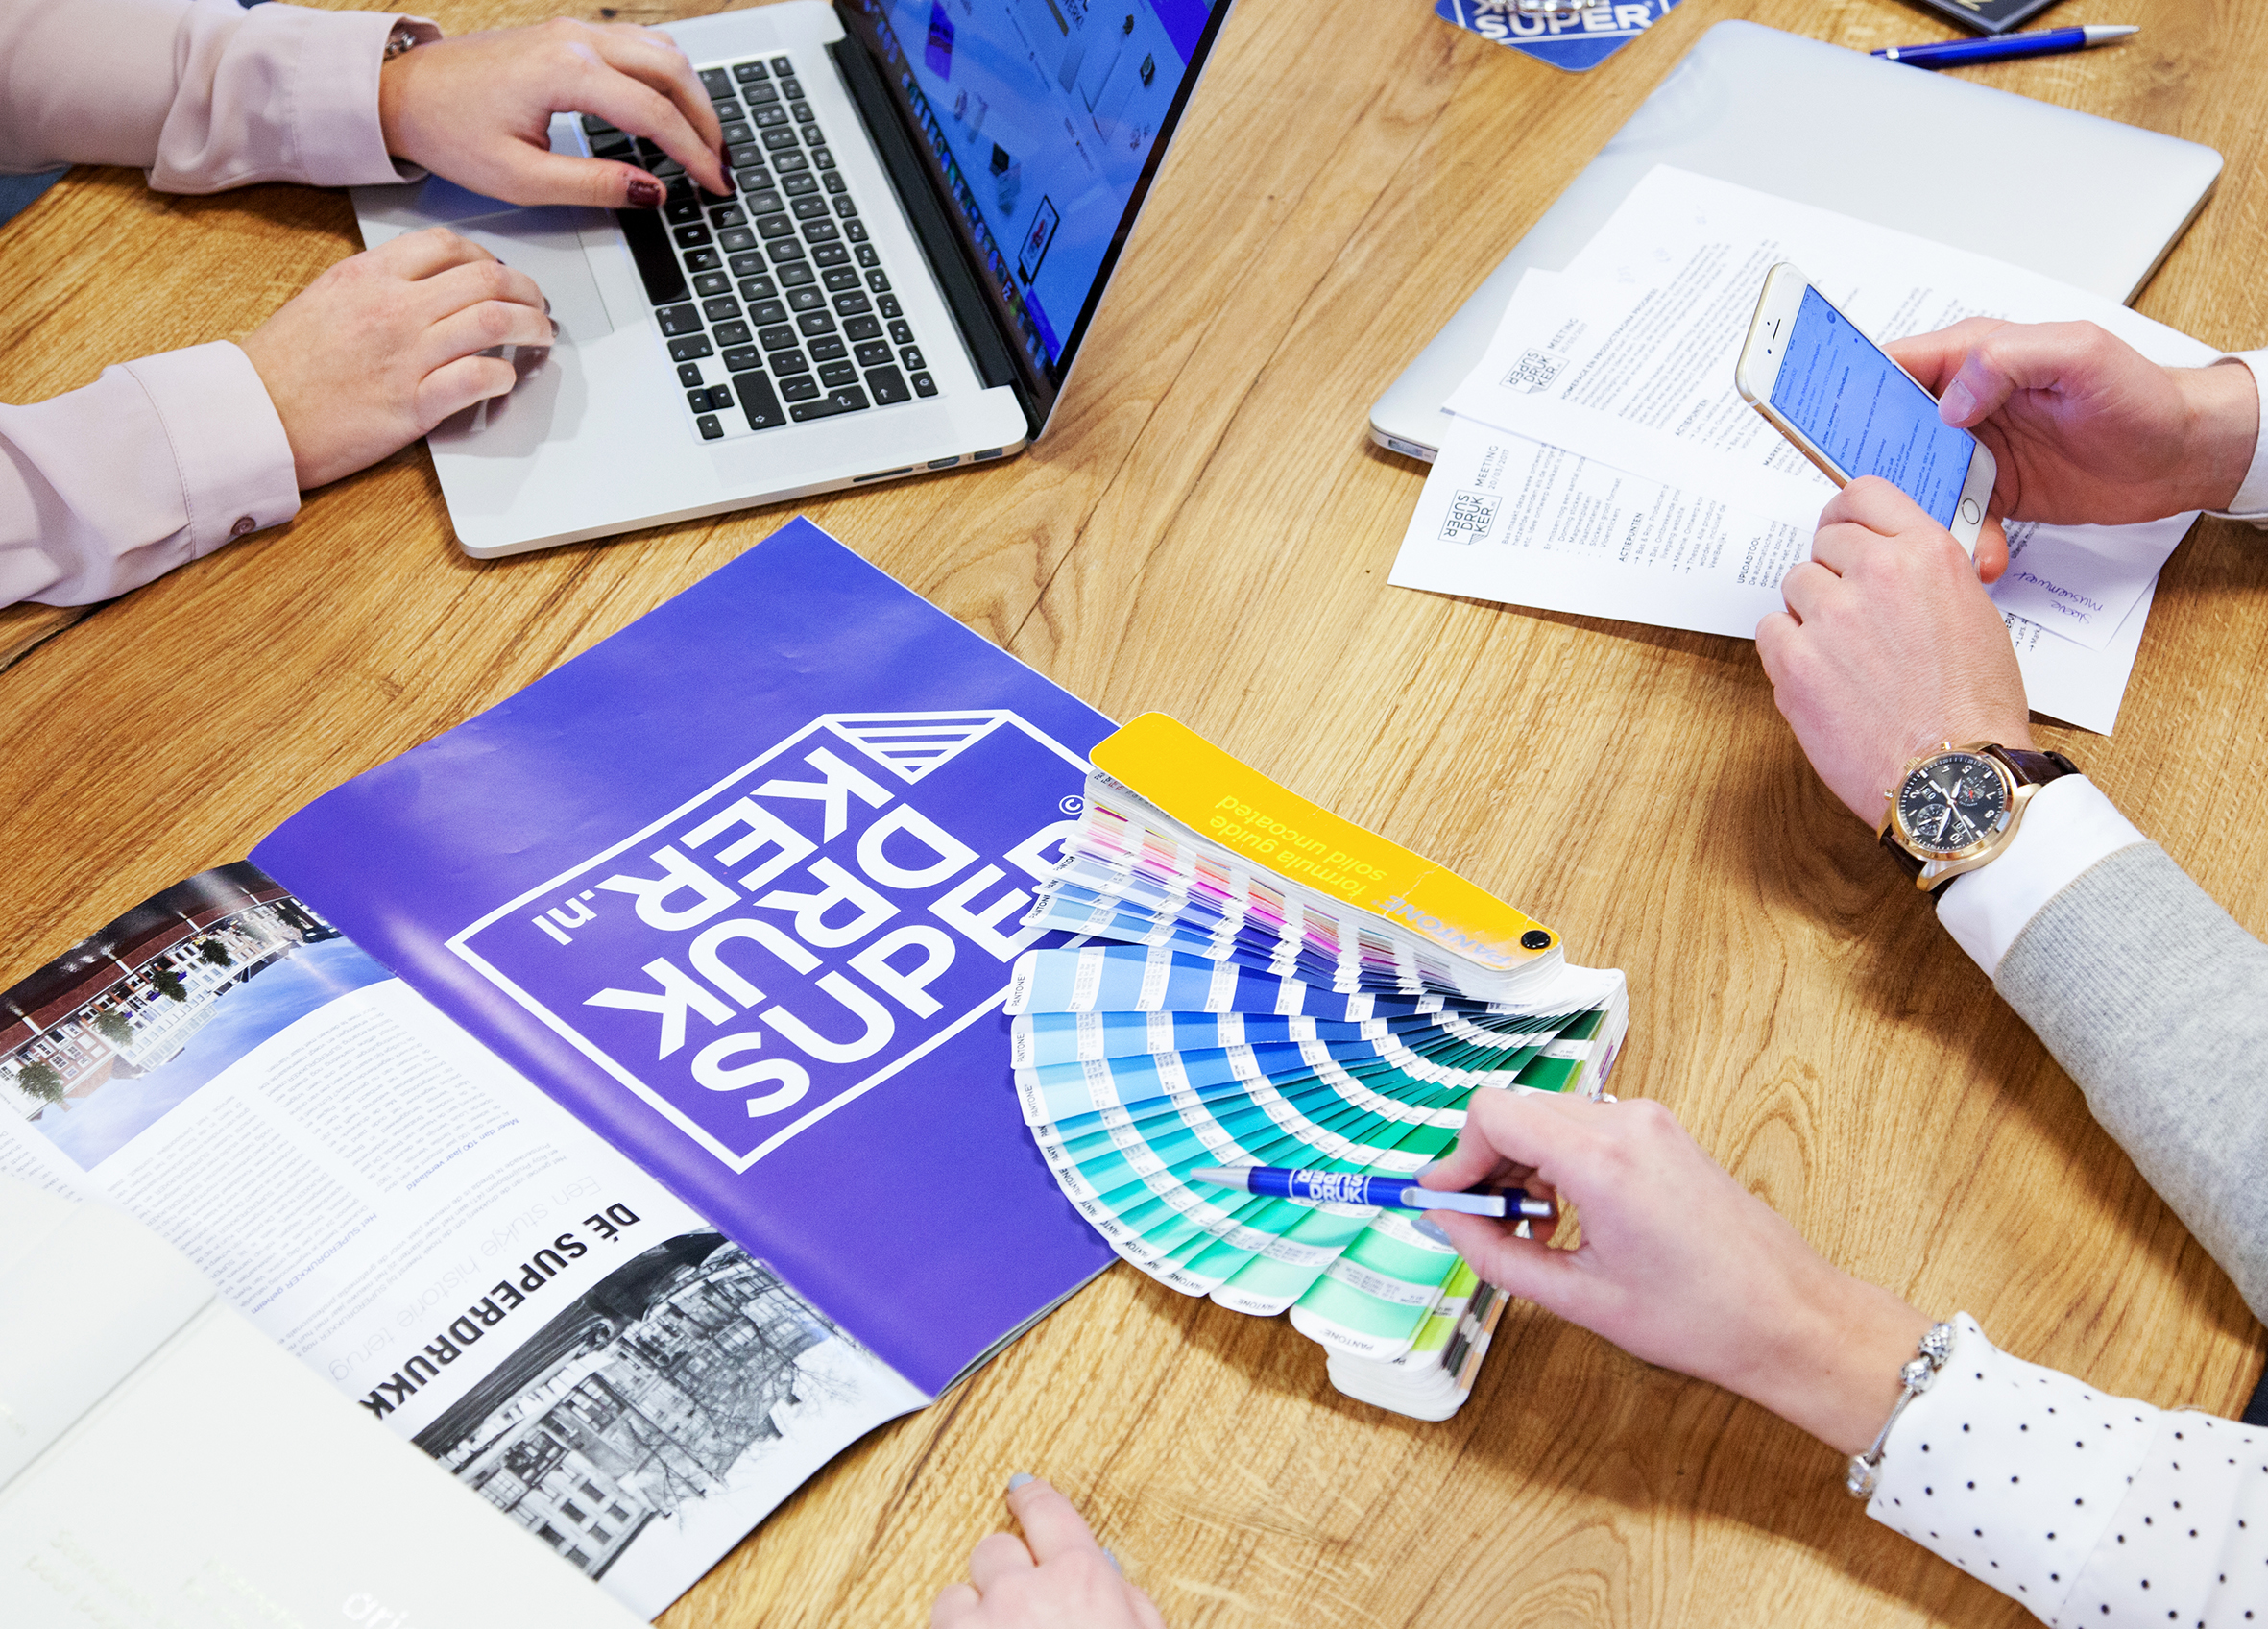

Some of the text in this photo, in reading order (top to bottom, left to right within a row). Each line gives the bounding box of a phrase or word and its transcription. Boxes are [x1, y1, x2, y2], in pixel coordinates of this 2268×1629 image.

[1475, 3, 1653, 40] SUPER
[1547, 315, 1579, 350] MEETING
[1505, 350, 1539, 385] SUPER
[1523, 354, 1552, 382] DRUK
[1534, 364, 1558, 386] KER
[1675, 397, 1709, 437] ACTIEPUNTEN
[1474, 443, 1499, 488] MEETING
[1487, 448, 1510, 490] 20/03/2017
[1443, 494, 1470, 537] SUPER
[1460, 496, 1484, 530] DRUK
[1473, 506, 1493, 532] KER
[1617, 511, 1643, 562] ACTIEPUNTEN
[1736, 534, 1761, 585] UPLOADTOOL
[531, 746, 896, 945] KER .nl
[1209, 814, 1369, 897] formula guide
[1215, 795, 1387, 882] solid uncoated
[582, 802, 980, 1060] DRUK
[1011, 975, 1026, 1007] PANTONE
[1017, 1033, 1025, 1062] PANTONE
[1025, 1085, 1040, 1118] PANTONE
[404, 1118, 519, 1191] Meer dan 100 jaar verslaafd
[1297, 1169, 1364, 1188] SUPER
[1309, 1184, 1364, 1204] DRUK
[580, 1204, 640, 1244] DÉ
[249, 1211, 377, 1316] Het SUPERDRUKKER geheim
[326, 1171, 602, 1384] Een stukje historie terug
[317, 1282, 388, 1341] SUPERDRUKKER
[1239, 1298, 1278, 1312] PANTONE
[1323, 1328, 1376, 1352] PANTONE
